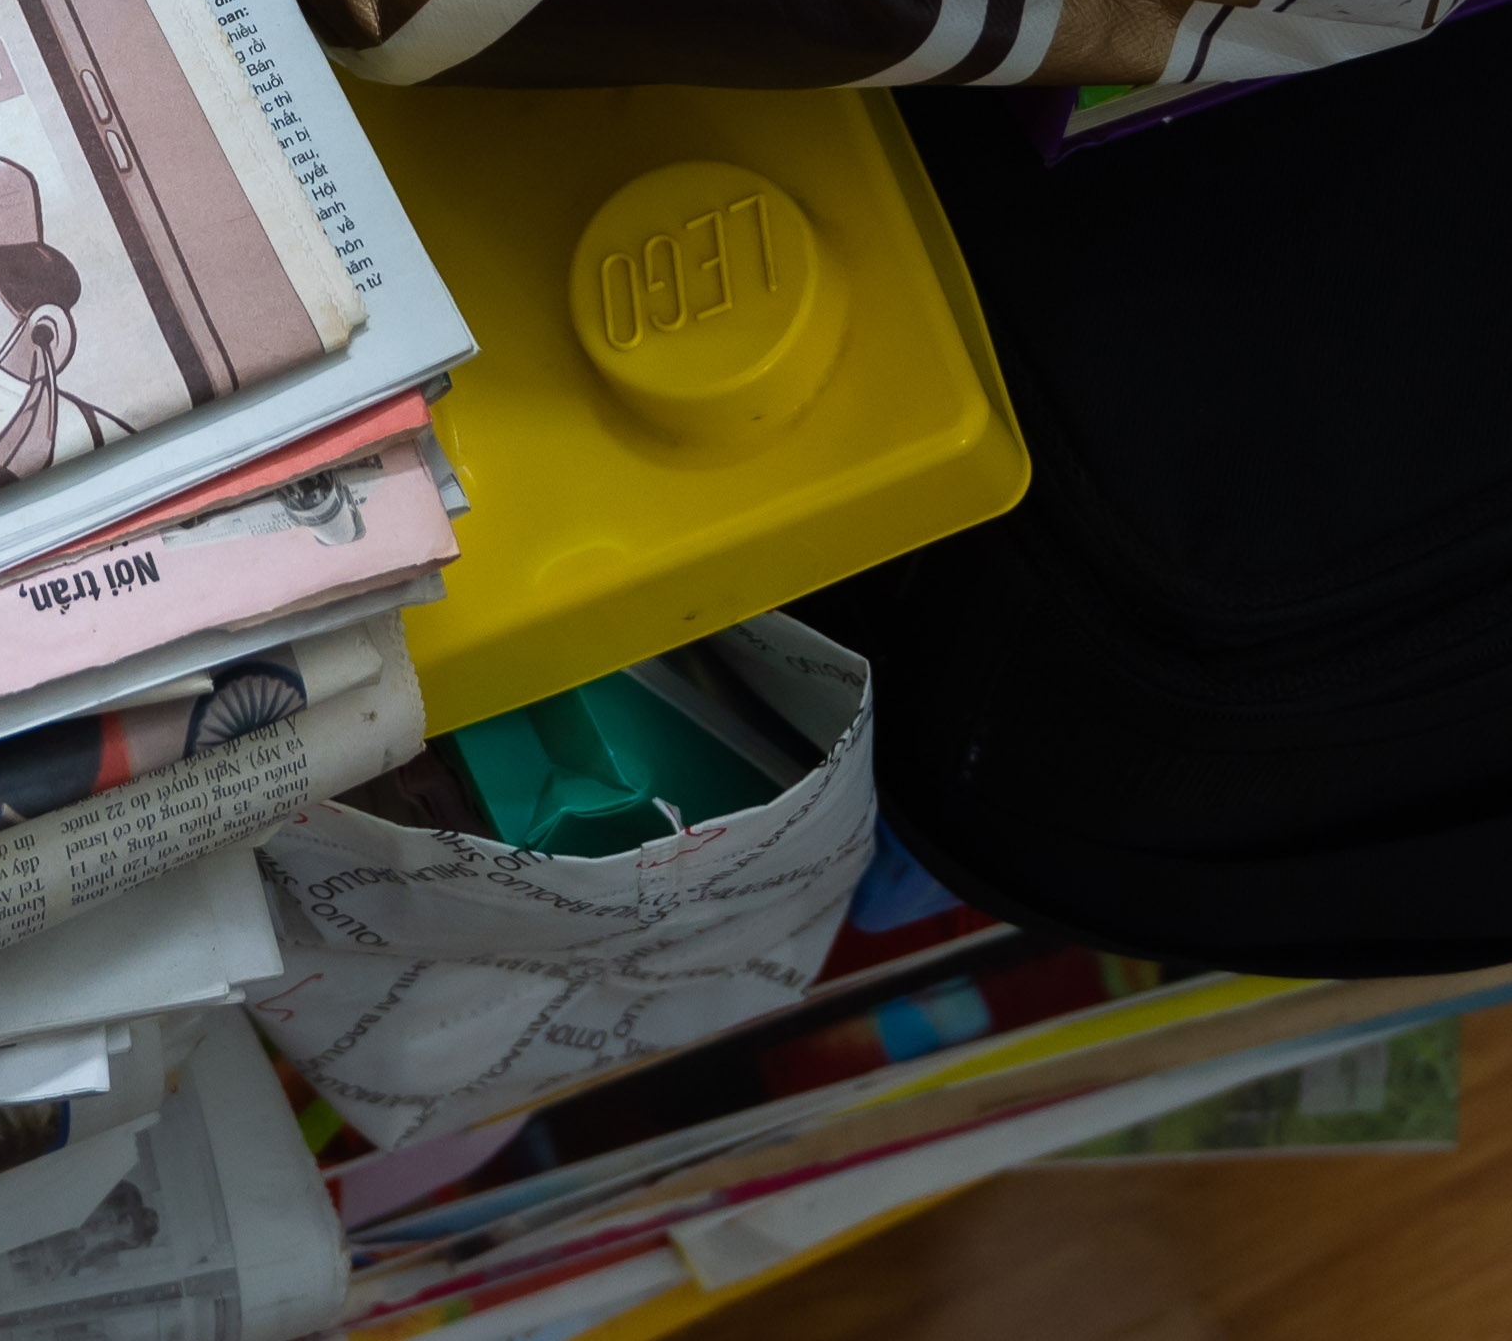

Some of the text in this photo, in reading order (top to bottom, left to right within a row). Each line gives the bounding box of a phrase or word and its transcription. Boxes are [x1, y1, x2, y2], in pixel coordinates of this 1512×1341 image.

[245, 58, 276, 78] Bán
[310, 180, 338, 202] Hội
[597, 192, 782, 348] LEGO
[18, 551, 161, 616] Nới trần,
